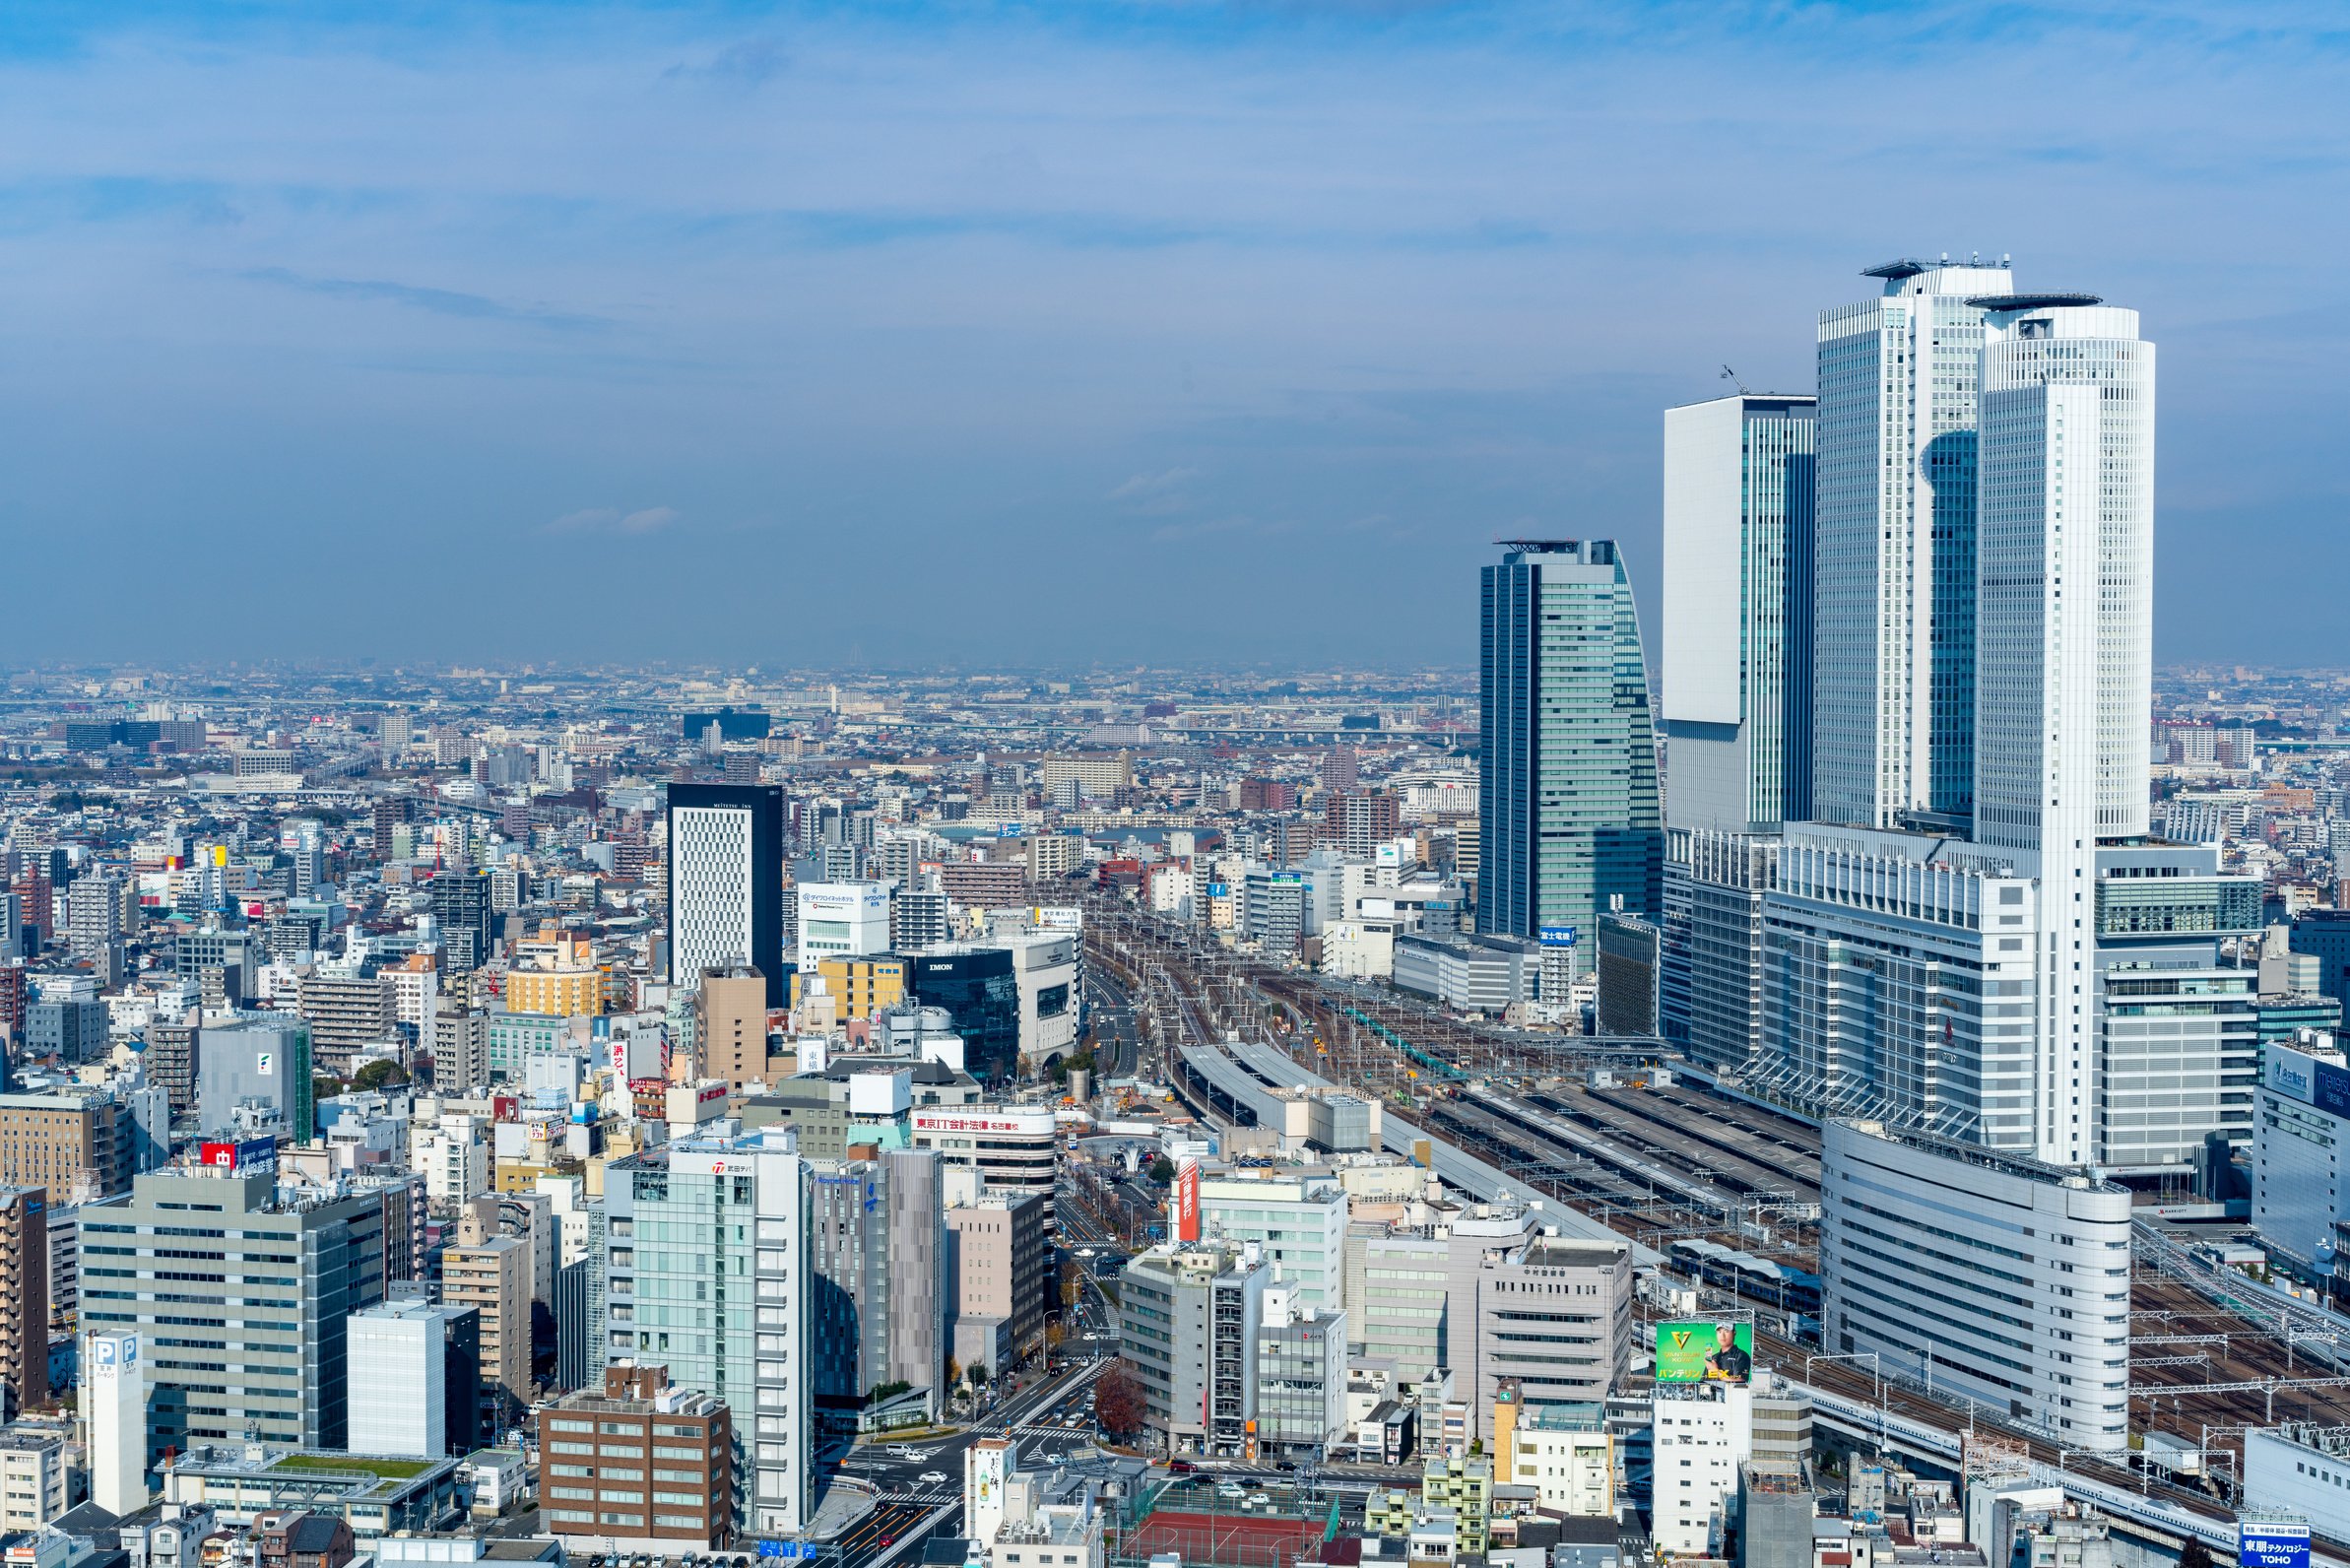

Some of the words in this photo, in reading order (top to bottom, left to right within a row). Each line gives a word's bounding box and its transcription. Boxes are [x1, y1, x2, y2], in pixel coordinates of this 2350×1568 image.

[1708, 1369, 1730, 1379] EX
[2245, 1539, 2310, 1553] 東朋テクノロジー
[2260, 1555, 2291, 1564] TOHO
